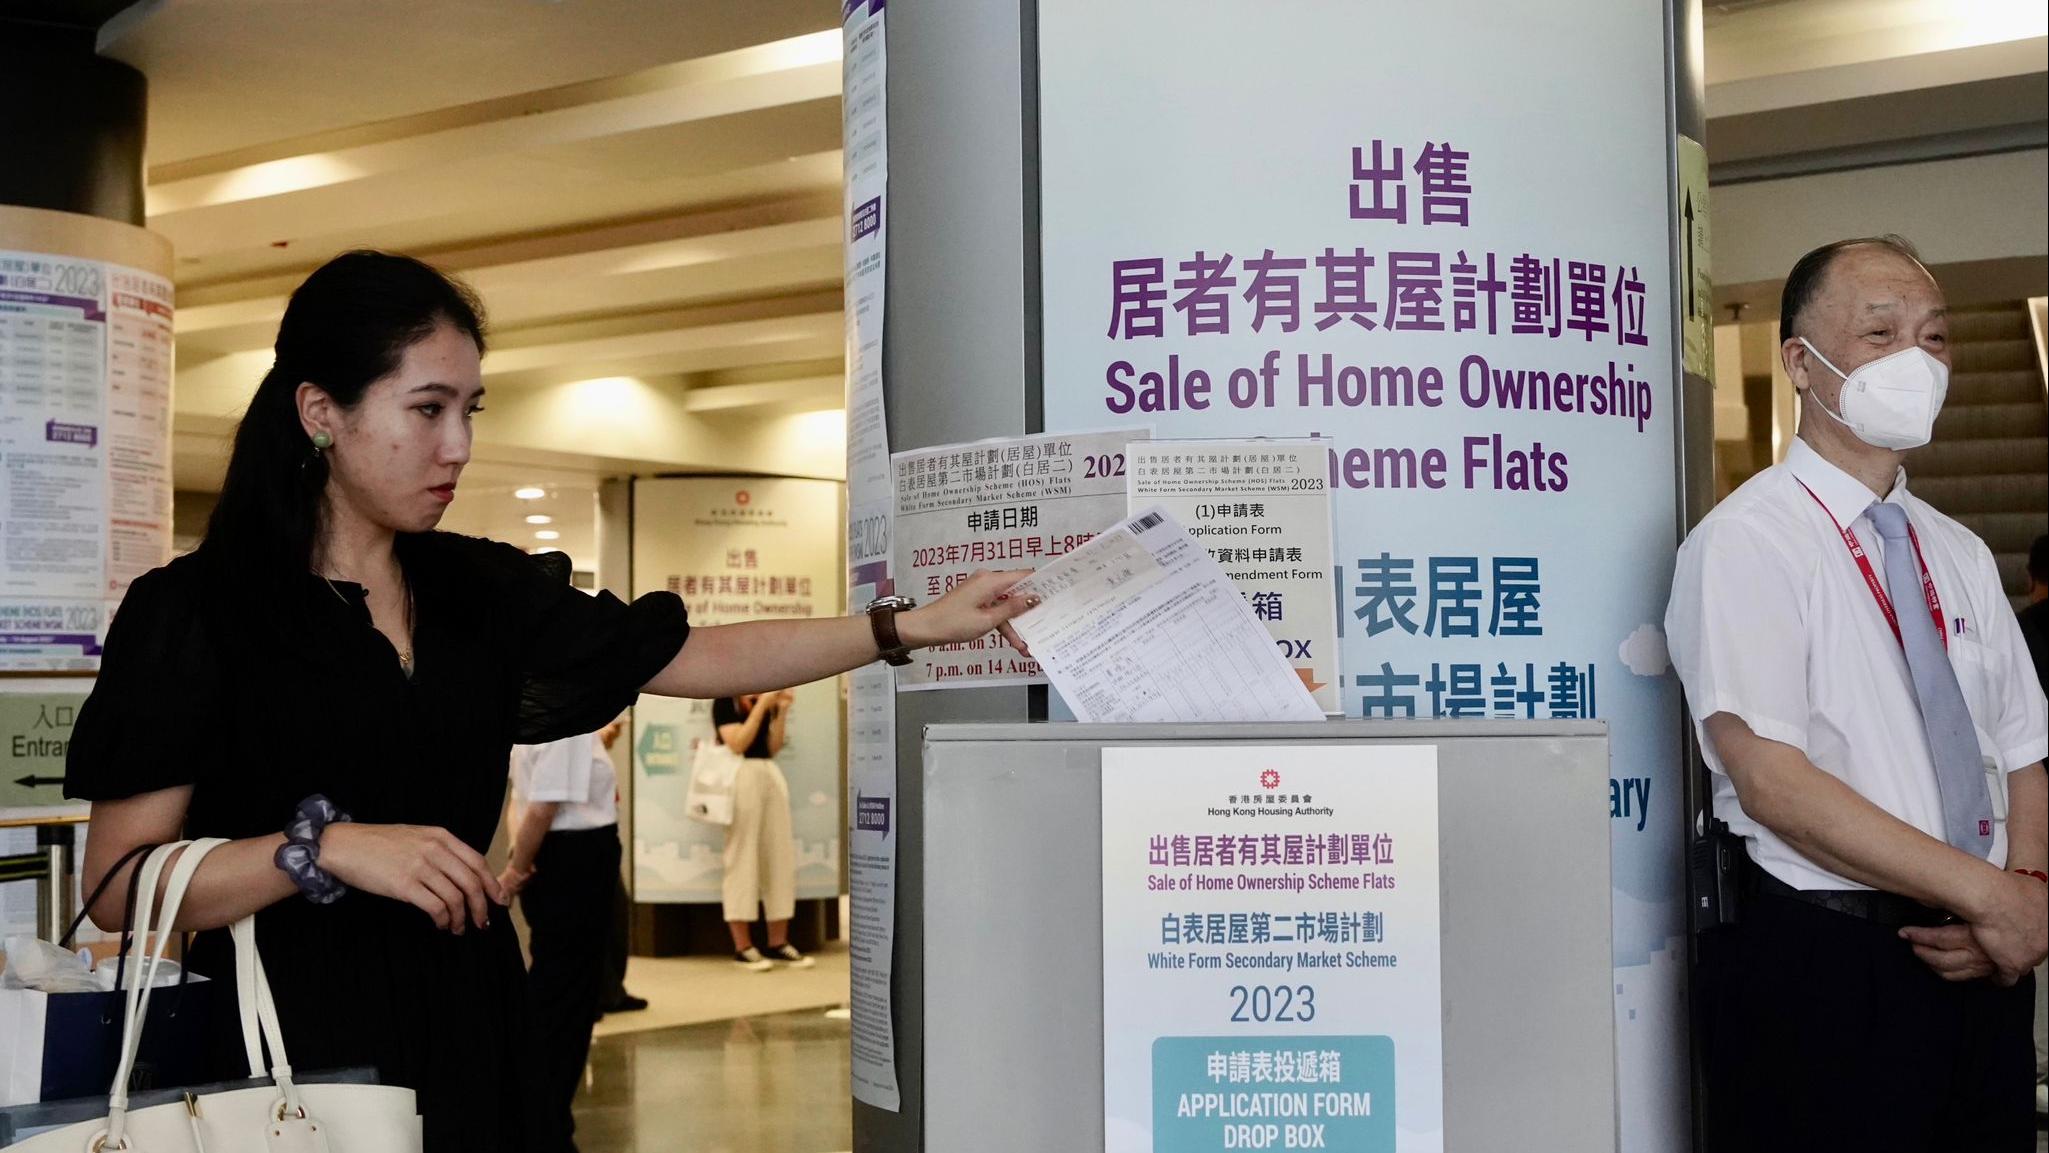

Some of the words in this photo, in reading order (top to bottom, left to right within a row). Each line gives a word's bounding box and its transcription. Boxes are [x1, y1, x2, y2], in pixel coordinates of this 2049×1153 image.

[1348, 139, 1472, 227] 出售
[55, 264, 99, 297] 2023
[1106, 247, 1649, 347] 居者有其屋計劃單位
[1105, 354, 1211, 415] Sale
[1228, 350, 1281, 408] of
[1298, 353, 1444, 408] Home
[1458, 354, 1652, 433] Ownership
[898, 442, 1072, 477] 出售居者有其屋計劃(居屋)單位
[1083, 453, 1126, 479] 202
[1463, 433, 1569, 492] Flats
[899, 459, 1073, 493] 白表居屋第二市場計劃(白居二)
[943, 485, 982, 496] Ownership
[984, 481, 1014, 491] Scheme
[1017, 479, 1045, 488] (HOS)
[1050, 477, 1071, 485] Flats
[1291, 478, 1324, 491] 2023
[937, 497, 972, 507] Secondary
[976, 493, 1003, 502] Market
[1006, 490, 1037, 499] Scheme
[1040, 486, 1072, 496] (WSM)
[1178, 486, 1212, 494] Secondary
[967, 505, 1038, 533] 申請日期
[1195, 503, 1265, 520] (1)申請表
[863, 514, 887, 558] 2023
[1188, 524, 1248, 538] pplication
[1251, 524, 1282, 535] Form
[1225, 569, 1289, 580] mendment
[1292, 569, 1323, 580] Form
[1241, 591, 1283, 621] 箱
[1334, 552, 1543, 638] 表居屋
[969, 638, 985, 650] on
[989, 633, 1004, 649] 31
[1275, 639, 1312, 659] OX
[926, 663, 933, 677] 7
[936, 665, 963, 681] p.m.
[966, 663, 983, 675] on
[988, 659, 1003, 674] 14
[1006, 659, 1044, 677] Augu
[33, 704, 73, 729] 入口
[12, 735, 69, 757] Entra
[1207, 806, 1231, 818] Hong
[1233, 806, 1256, 818] Kong
[1257, 806, 1293, 818] Housing
[1294, 806, 1334, 817] Authority
[1228, 794, 1313, 805] 香港房屋委員會
[1148, 832, 1394, 867] 出售居者有其屋計劃單位
[1147, 875, 1176, 891] Sale
[1179, 874, 1193, 890] of
[1196, 874, 1233, 890] Home
[1237, 873, 1304, 893] Ownership
[1308, 873, 1360, 890] Scheme
[1362, 873, 1395, 889] Flats
[1161, 911, 1384, 945] 白表居屋第二市場計劃
[1147, 953, 1185, 969] White
[1188, 953, 1222, 969] Form
[1225, 952, 1294, 972] Secondary
[1297, 952, 1342, 968] Market
[1345, 951, 1397, 968] Scheme
[1229, 985, 1316, 1022] 2023
[1207, 1050, 1341, 1084] 申請表投遞箱
[1177, 1093, 1308, 1118] APPLICATION
[1314, 1092, 1370, 1117] FORM
[1224, 1124, 1279, 1149] DROP
[1284, 1124, 1325, 1149] BOX
